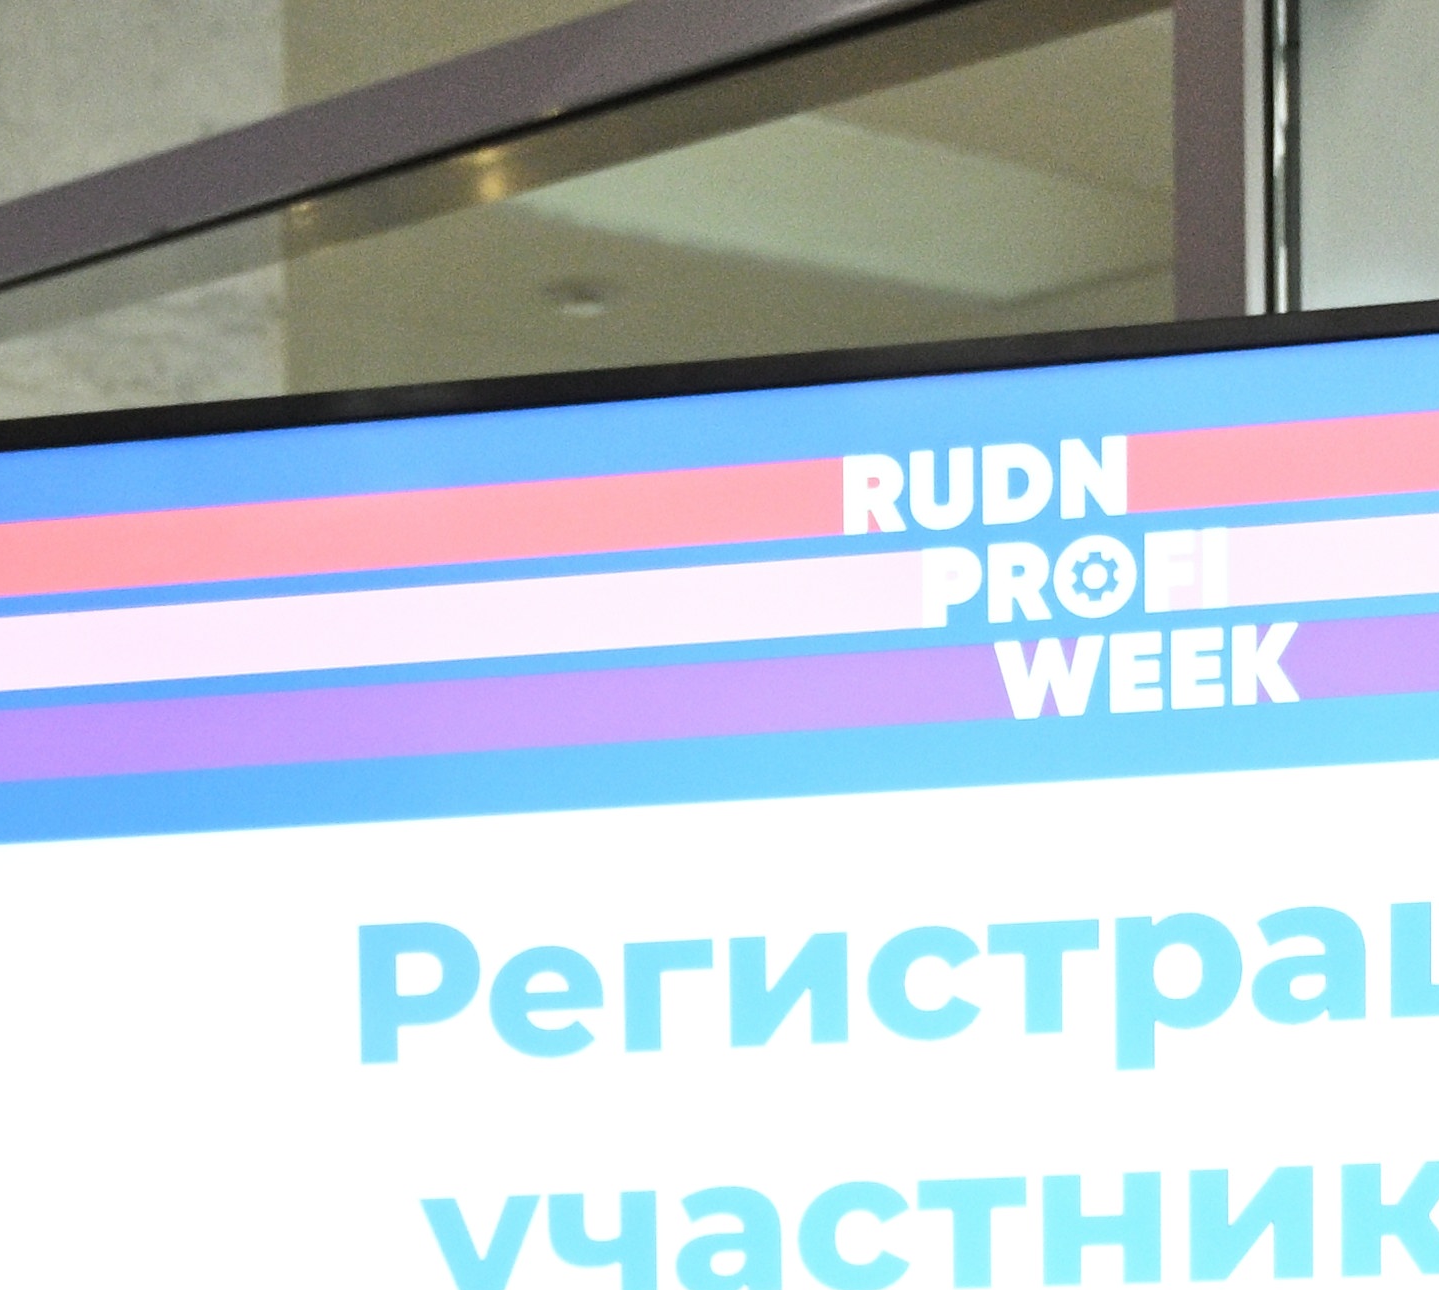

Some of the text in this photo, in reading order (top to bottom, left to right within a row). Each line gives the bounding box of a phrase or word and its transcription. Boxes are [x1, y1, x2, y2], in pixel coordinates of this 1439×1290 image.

[842, 435, 1128, 536] RUDN
[922, 527, 1228, 628] PROFI
[994, 621, 1300, 720] WEEK
